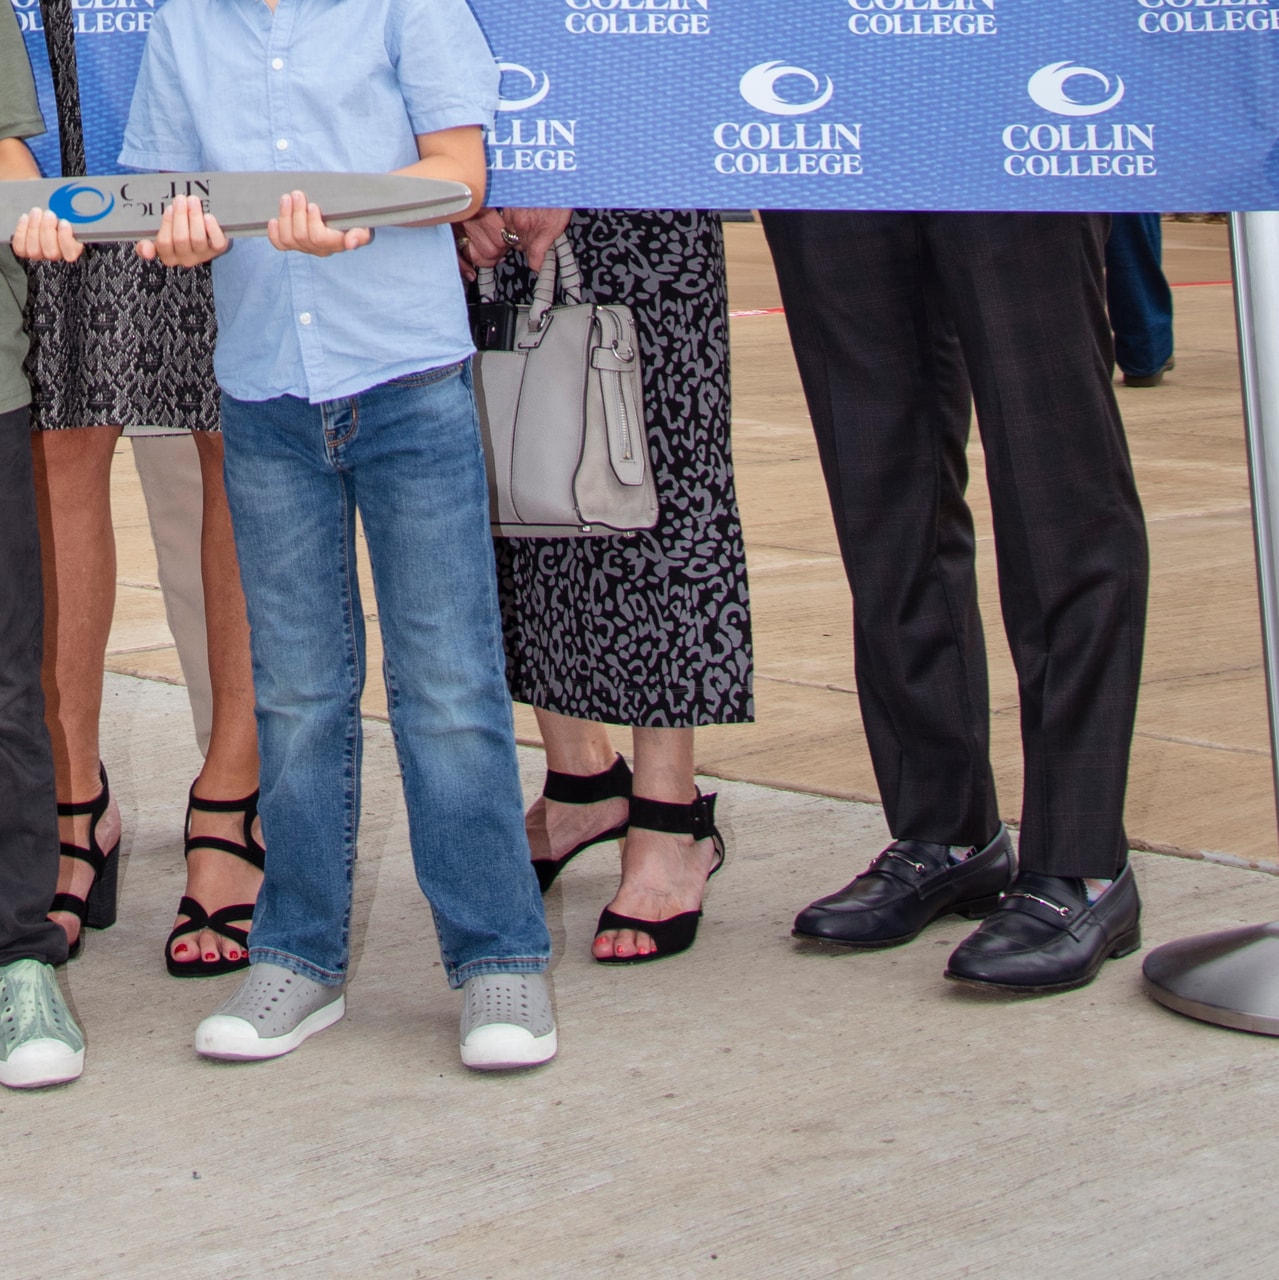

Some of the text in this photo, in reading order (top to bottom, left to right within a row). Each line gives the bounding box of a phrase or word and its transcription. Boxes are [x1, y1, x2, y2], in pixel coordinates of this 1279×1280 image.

[564, 13, 711, 35] COLLEGE
[847, 13, 998, 36] COLLEGE
[713, 122, 862, 150] COLLIN
[1002, 123, 1155, 151] COLLIN
[714, 153, 863, 175] COLLEGE
[1003, 154, 1157, 177] COLLEGE
